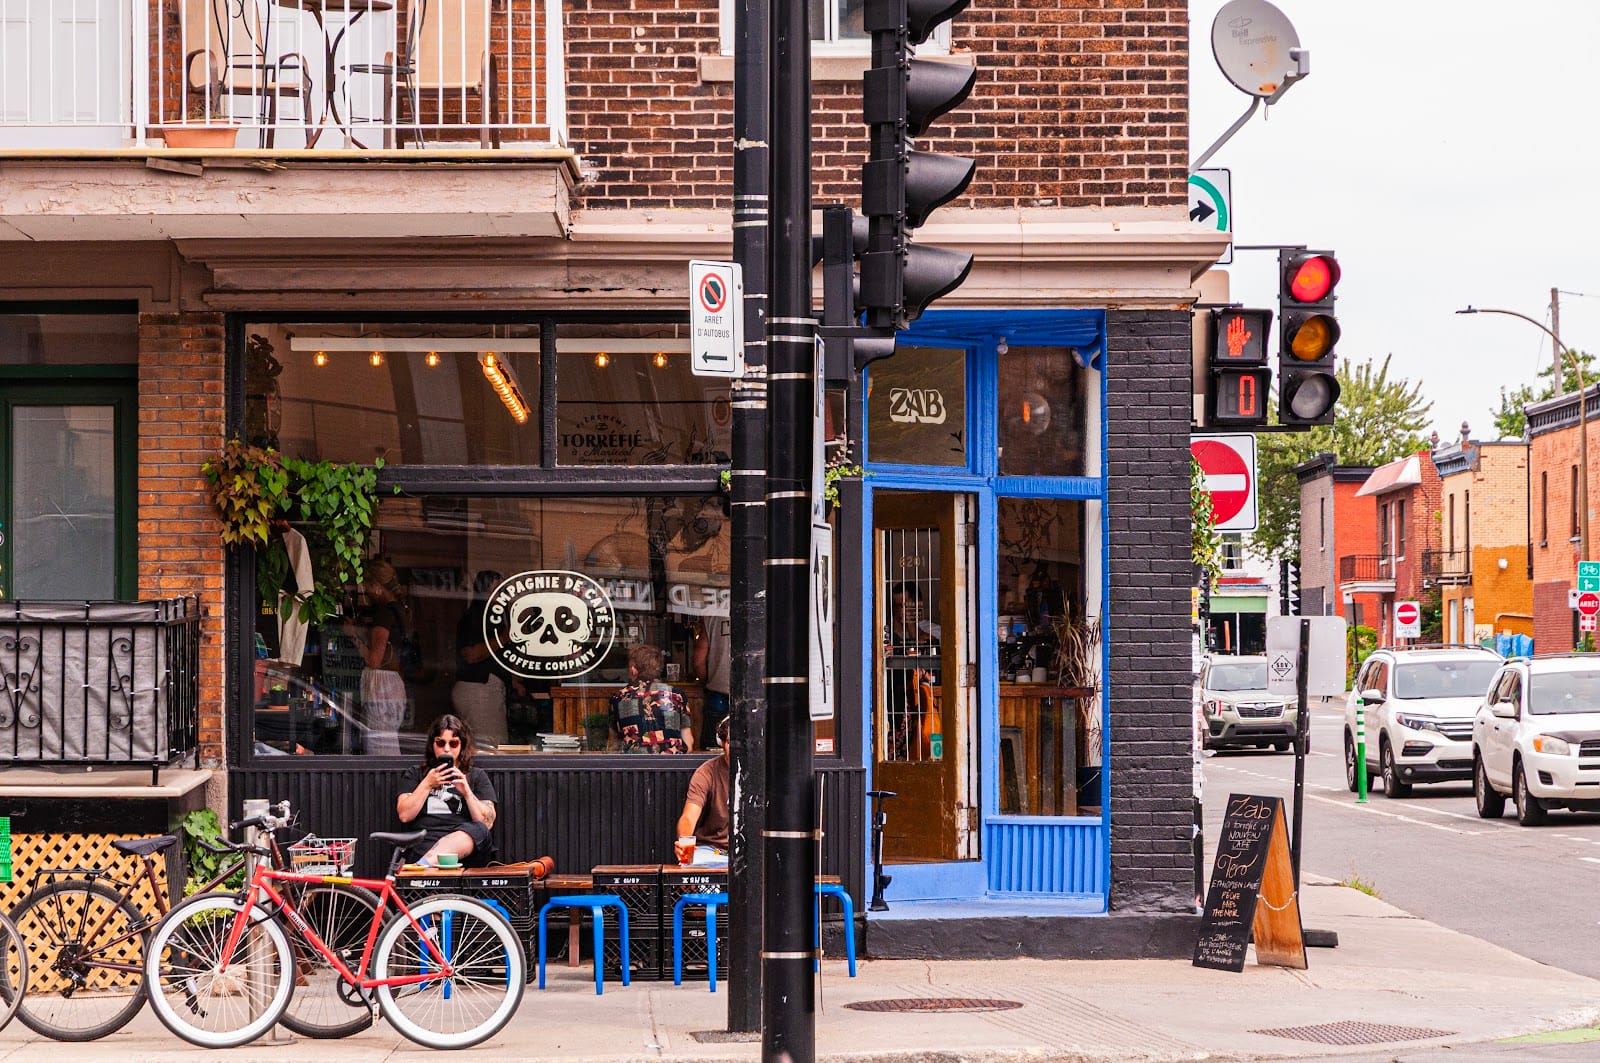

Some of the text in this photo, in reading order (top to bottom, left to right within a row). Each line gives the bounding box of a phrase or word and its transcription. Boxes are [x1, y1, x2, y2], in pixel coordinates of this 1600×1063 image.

[1231, 28, 1249, 38] Bell
[704, 315, 723, 325] ARRÊT
[697, 328, 730, 339] D'AUTOBUS
[889, 388, 947, 425] ZAB
[561, 430, 643, 448] TORRÉFIÉ
[489, 576, 560, 625] COMPAGNIE
[564, 577, 584, 593] DE
[584, 588, 612, 624] CAFÉ
[503, 648, 596, 671] COFFEE COMPANY
[1230, 796, 1272, 820] Zab
